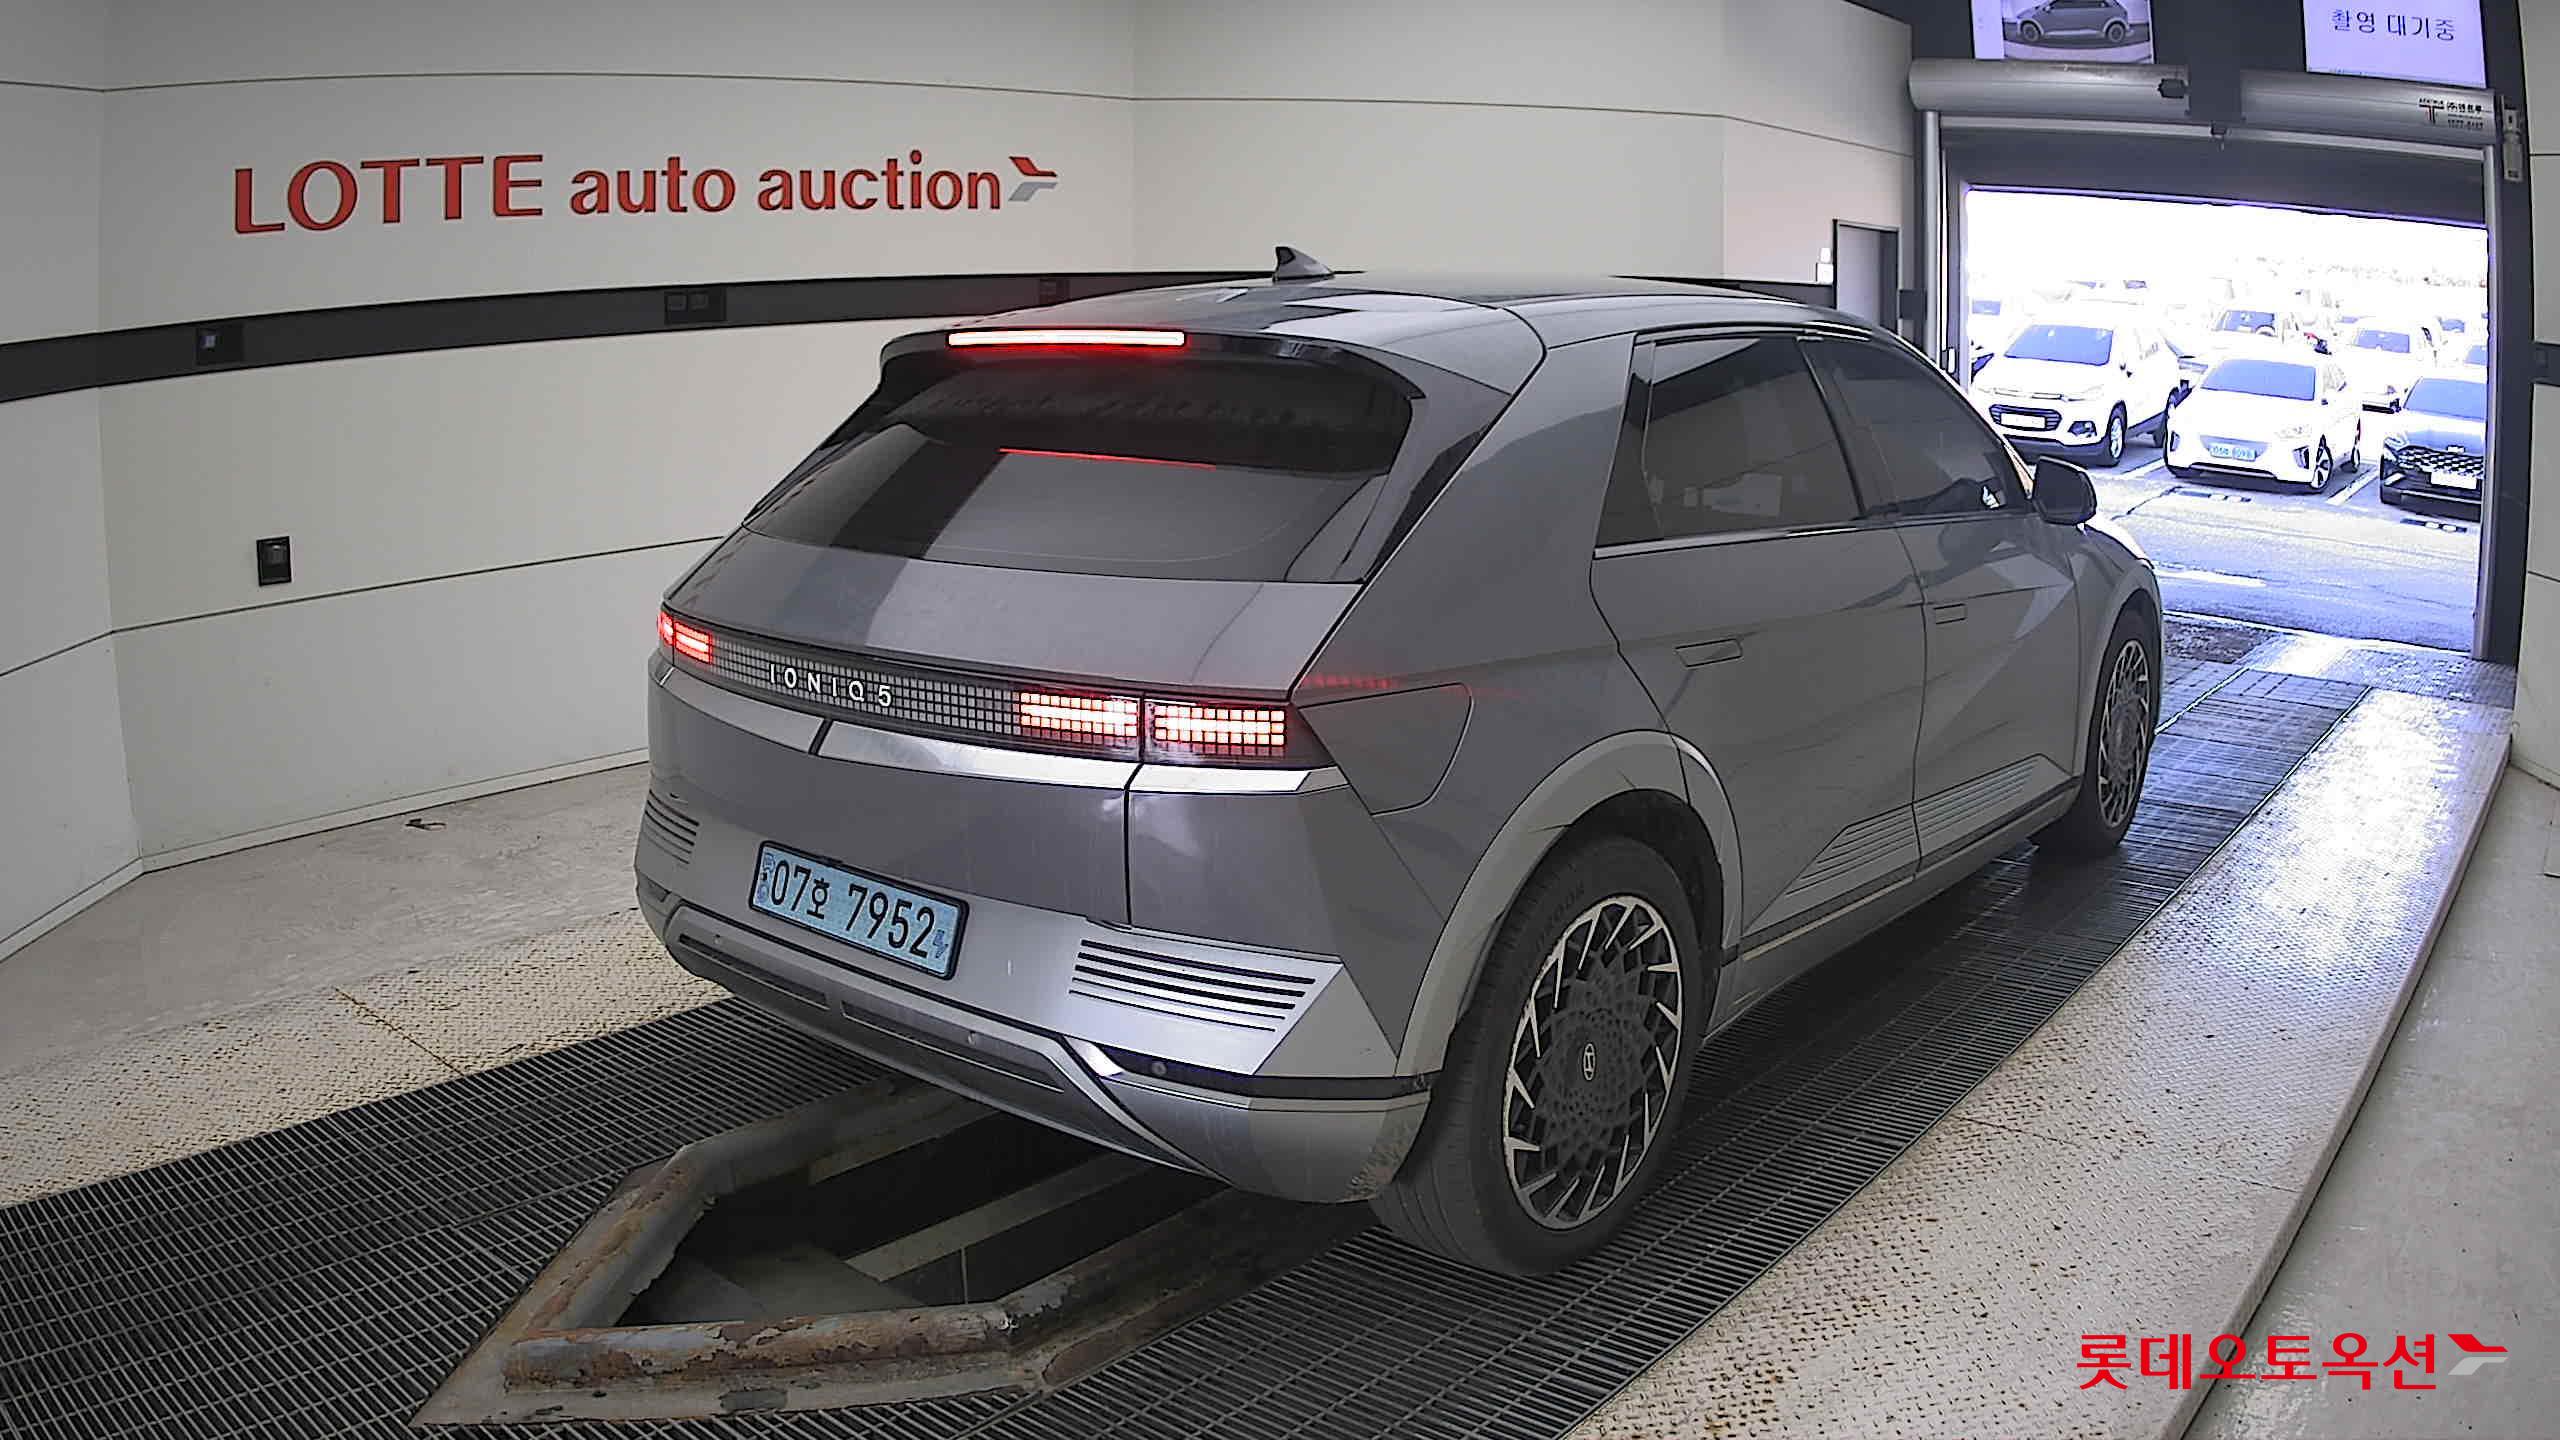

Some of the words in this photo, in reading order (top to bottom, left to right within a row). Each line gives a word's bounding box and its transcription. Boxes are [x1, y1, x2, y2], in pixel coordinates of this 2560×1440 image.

[2387, 14, 2455, 41] 대기중
[235, 154, 543, 234] LOTTE
[569, 156, 736, 215] auto
[757, 149, 1001, 211] auction
[770, 663, 865, 702] IONIQ
[878, 684, 892, 707] 5
[770, 859, 830, 919] 07호
[845, 883, 936, 958] 7952
